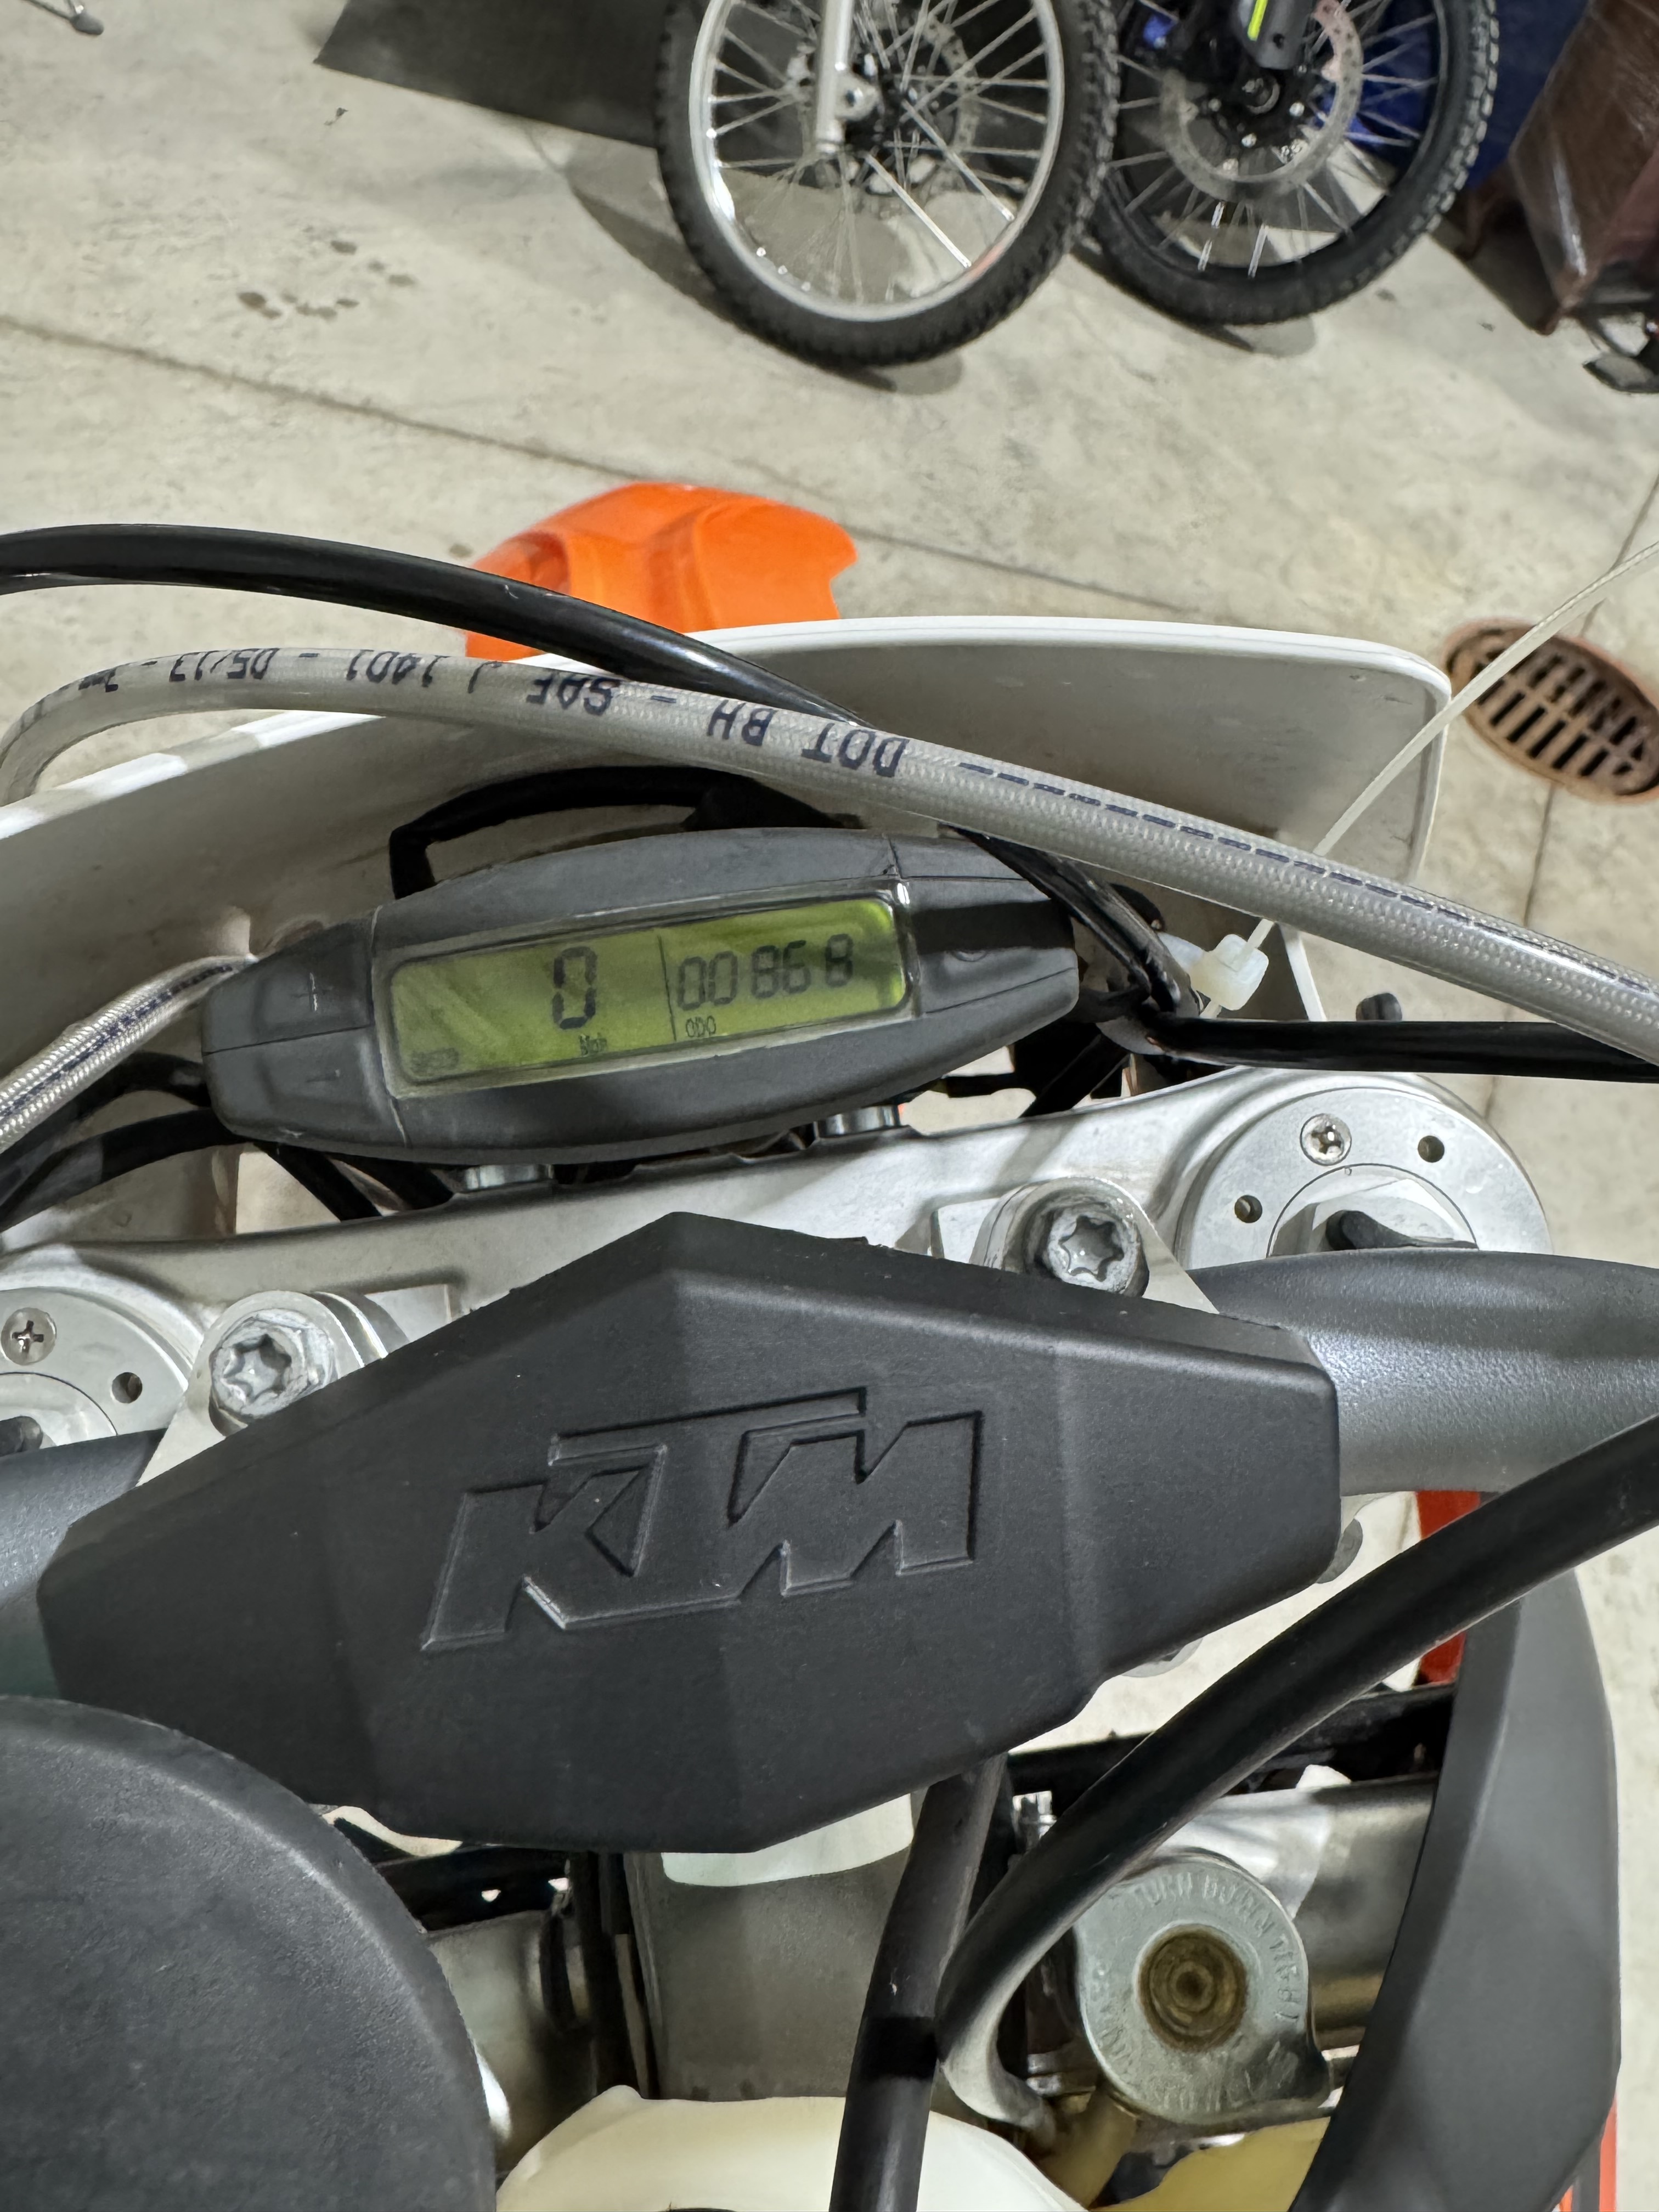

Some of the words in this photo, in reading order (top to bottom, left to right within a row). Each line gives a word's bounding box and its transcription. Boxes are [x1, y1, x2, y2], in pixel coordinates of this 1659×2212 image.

[707, 701, 776, 746] BH
[801, 721, 909, 777] DOT
[552, 946, 597, 1030] 0
[686, 1015, 716, 1037] ODO
[421, 1386, 983, 1650] KTM
